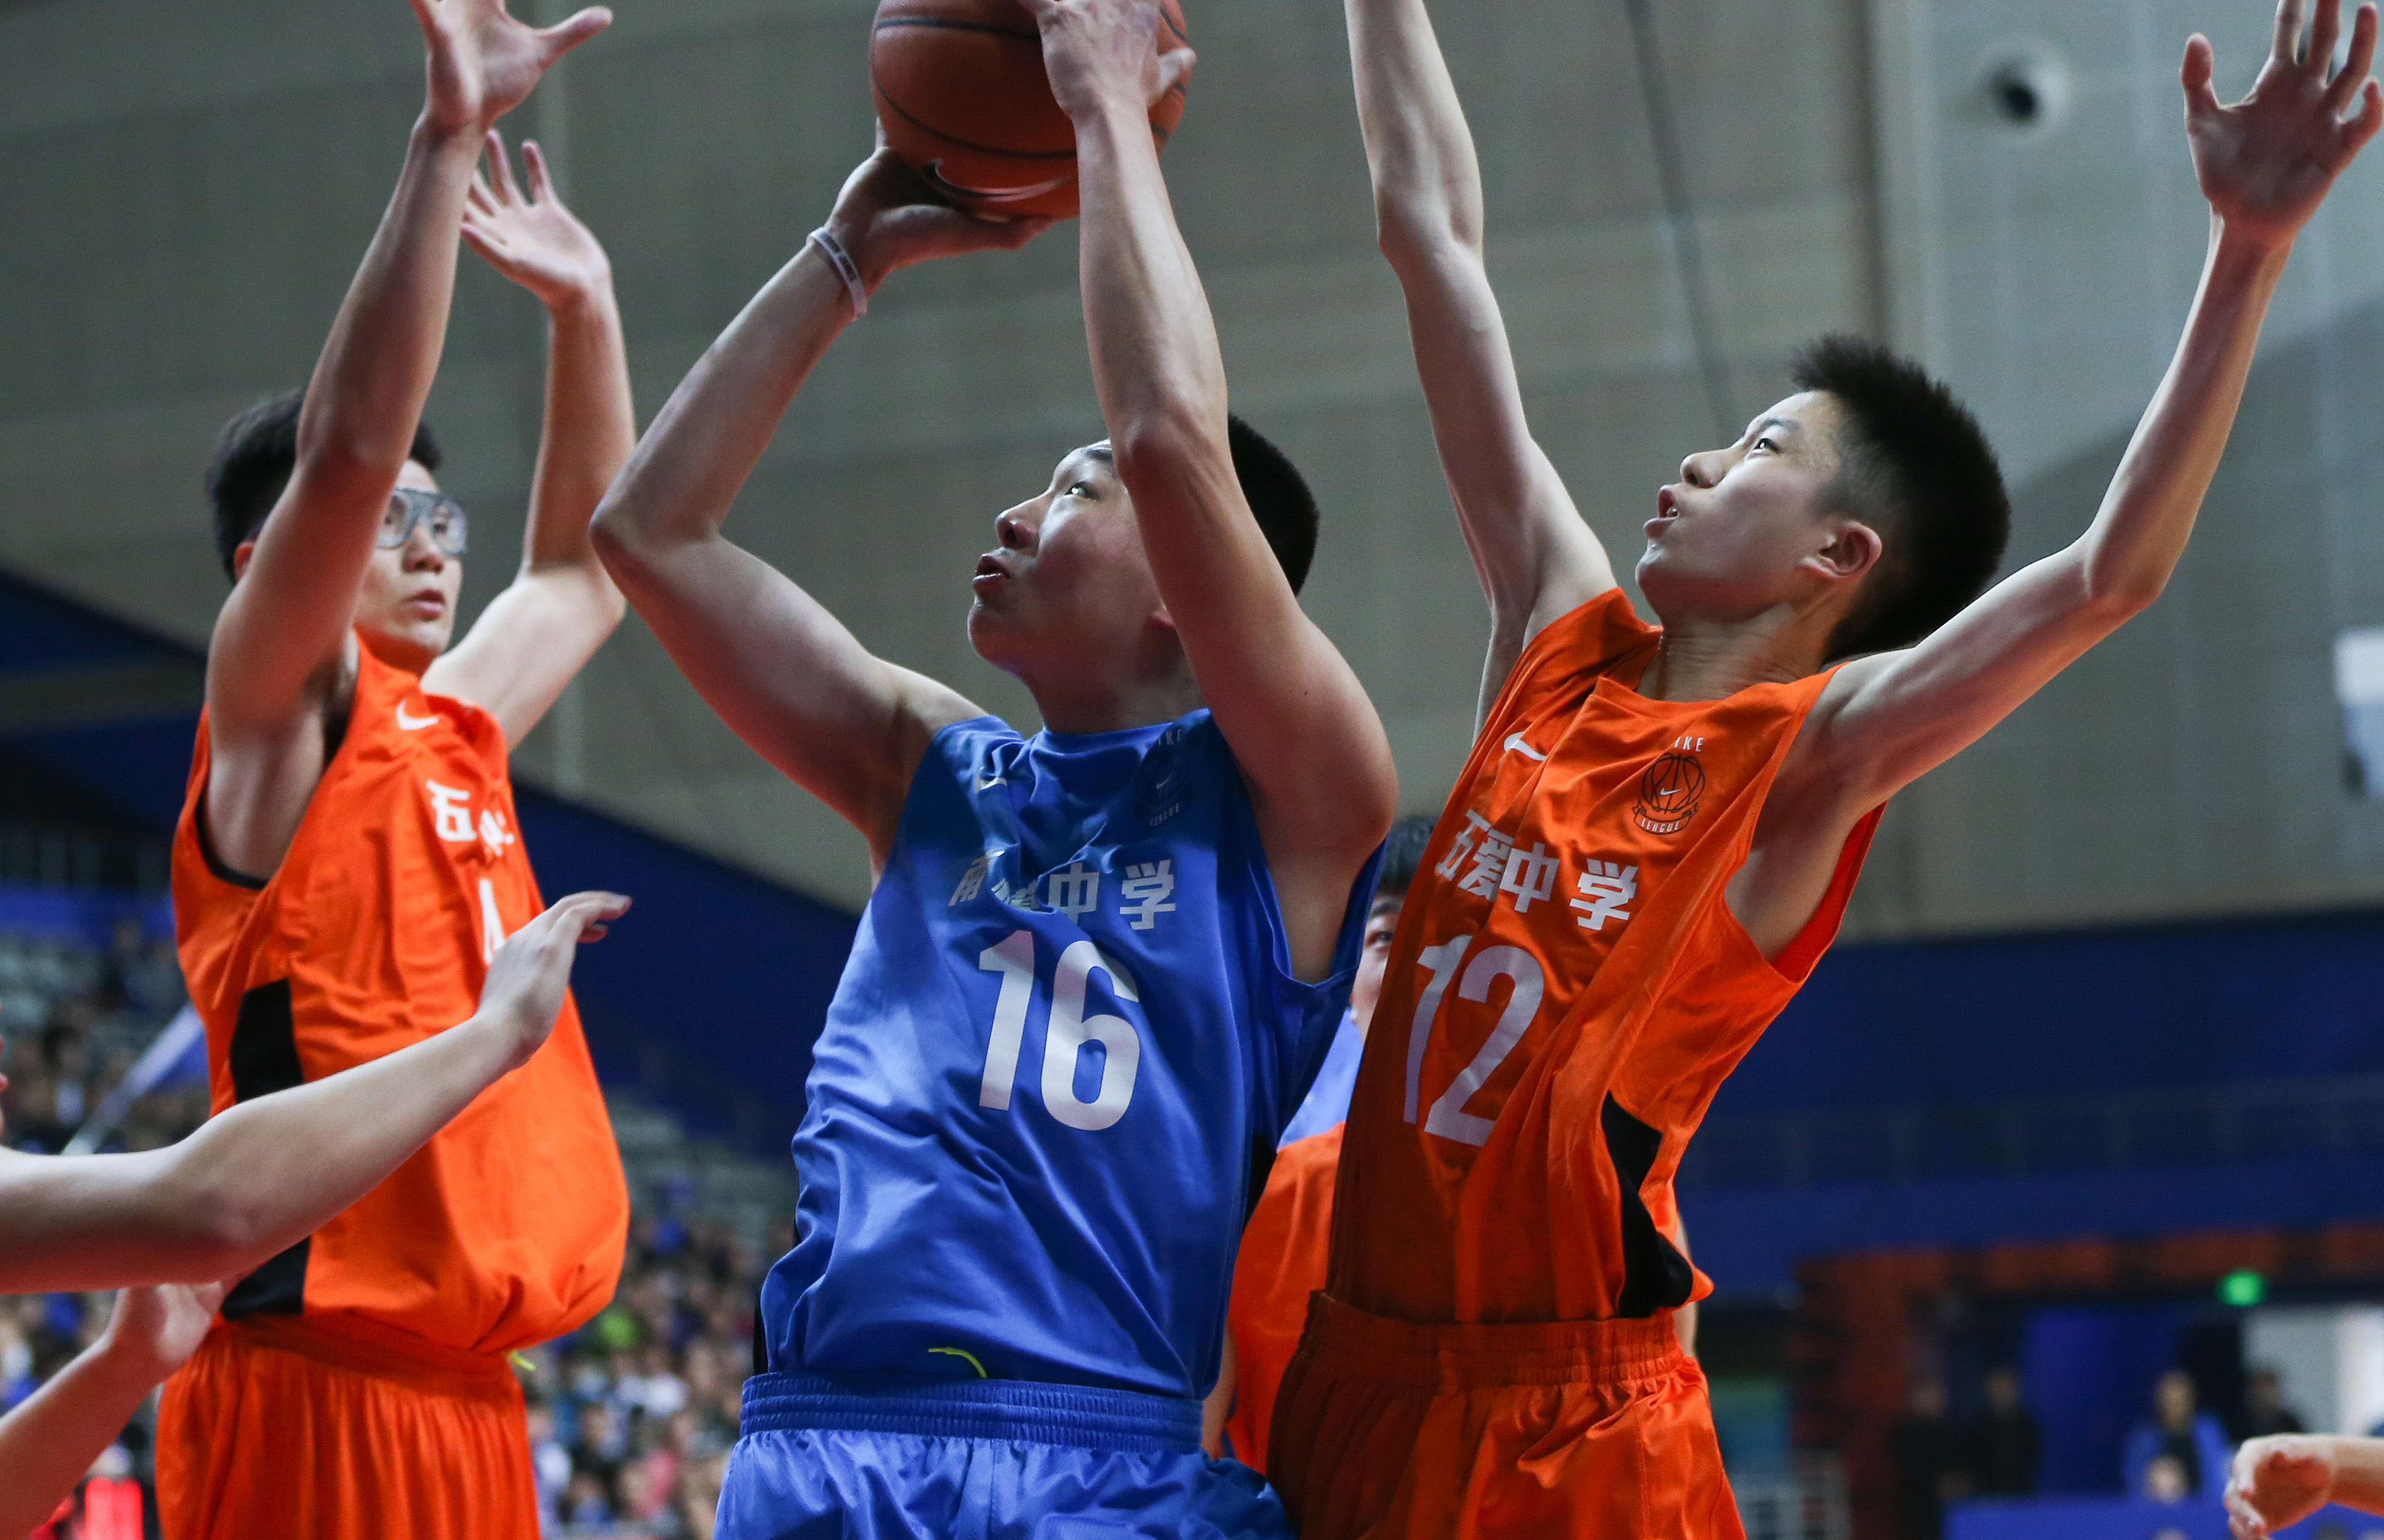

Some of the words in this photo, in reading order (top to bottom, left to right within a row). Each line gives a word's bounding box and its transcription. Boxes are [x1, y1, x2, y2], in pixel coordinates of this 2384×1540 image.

[1158, 729, 1182, 746] IKE
[1674, 736, 1704, 752] IKE
[1641, 818, 1681, 833] LEAGUE
[979, 930, 1140, 1131] 16
[1403, 934, 1545, 1148] 12
